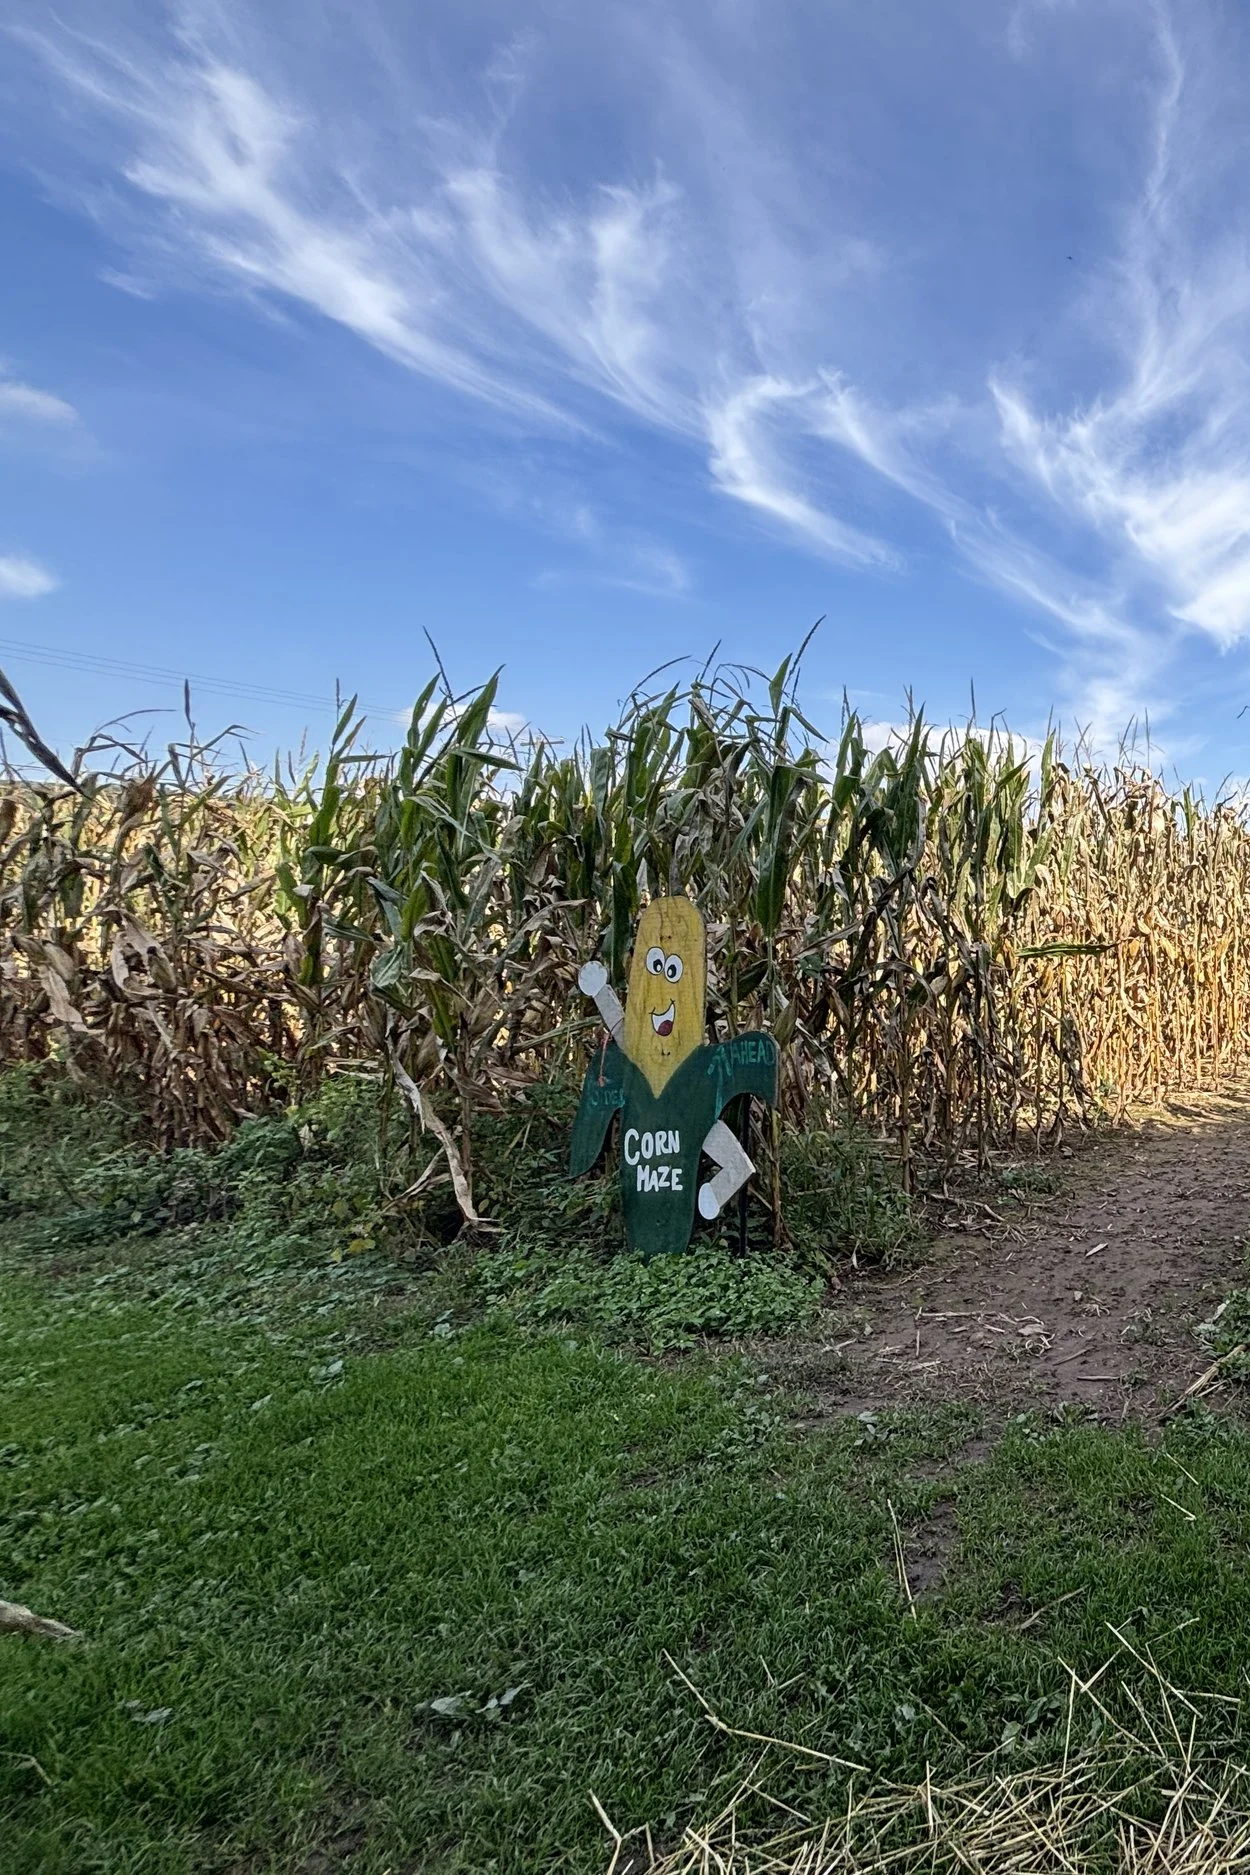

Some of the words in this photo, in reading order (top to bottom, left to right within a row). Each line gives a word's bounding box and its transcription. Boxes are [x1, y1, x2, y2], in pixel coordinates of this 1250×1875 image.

[731, 1039, 776, 1066] AHEAD
[624, 1128, 680, 1165] CORN
[636, 1165, 683, 1192] MAZE
